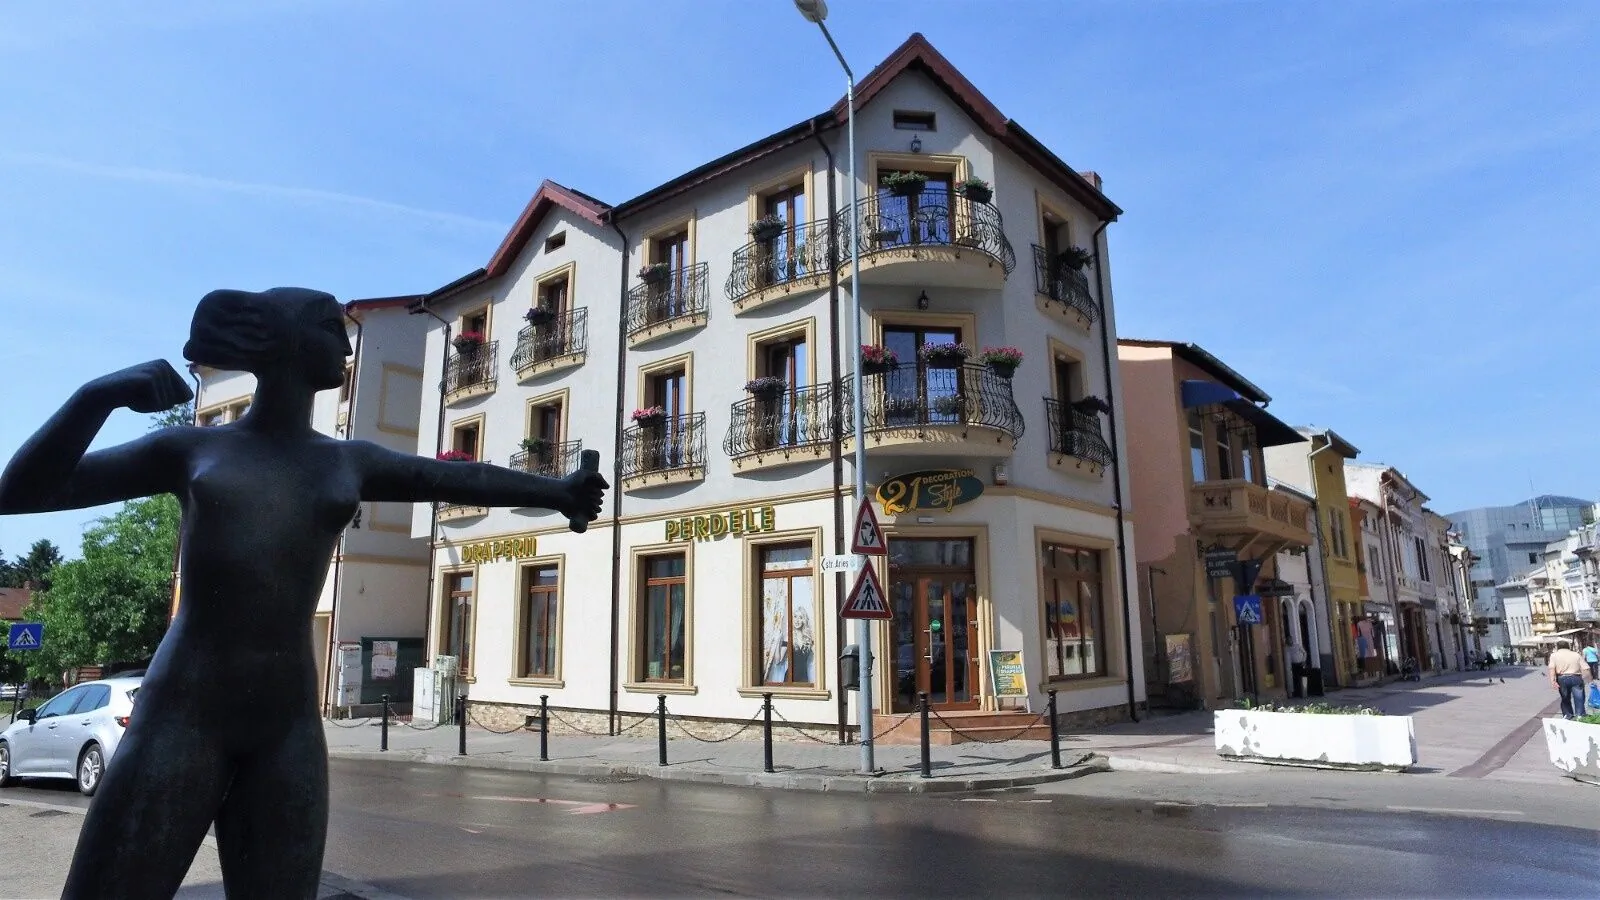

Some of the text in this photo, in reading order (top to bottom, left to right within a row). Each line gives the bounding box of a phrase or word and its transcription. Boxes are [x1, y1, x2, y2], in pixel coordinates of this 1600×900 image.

[922, 467, 974, 484] DECORATION
[876, 477, 921, 515] 21
[928, 480, 962, 512] Style
[665, 505, 775, 542] PERDELE
[461, 537, 537, 564] DRAPERII
